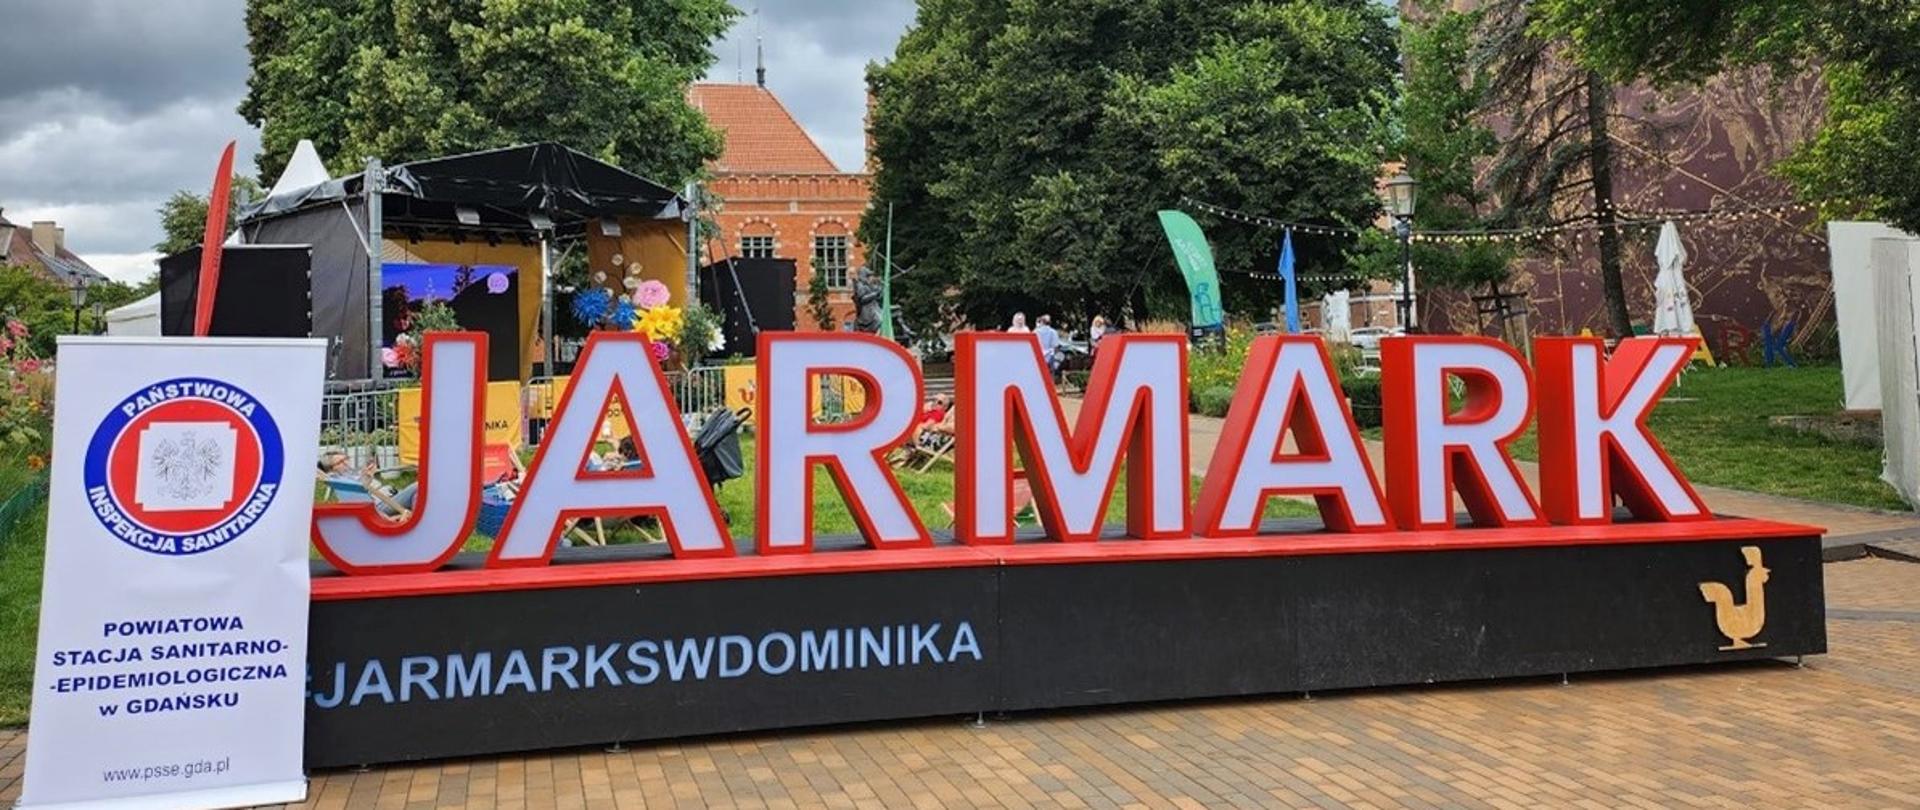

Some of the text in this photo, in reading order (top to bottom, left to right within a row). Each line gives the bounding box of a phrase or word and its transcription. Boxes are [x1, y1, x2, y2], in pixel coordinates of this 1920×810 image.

[122, 382, 257, 417] PAŃSTWOWA
[485, 420, 508, 431] NIKA
[310, 331, 1712, 576] JARMARK
[89, 483, 277, 552] INSPEKCJA SANITARNA
[103, 617, 243, 637] POWIATOWA
[53, 639, 289, 666] STACJA SANITARNO-
[50, 664, 288, 693] -EPIDEMIOLOGICZNA
[99, 692, 239, 716] w GDAŃSKU
[103, 757, 230, 782] www.psse.gda.pl
